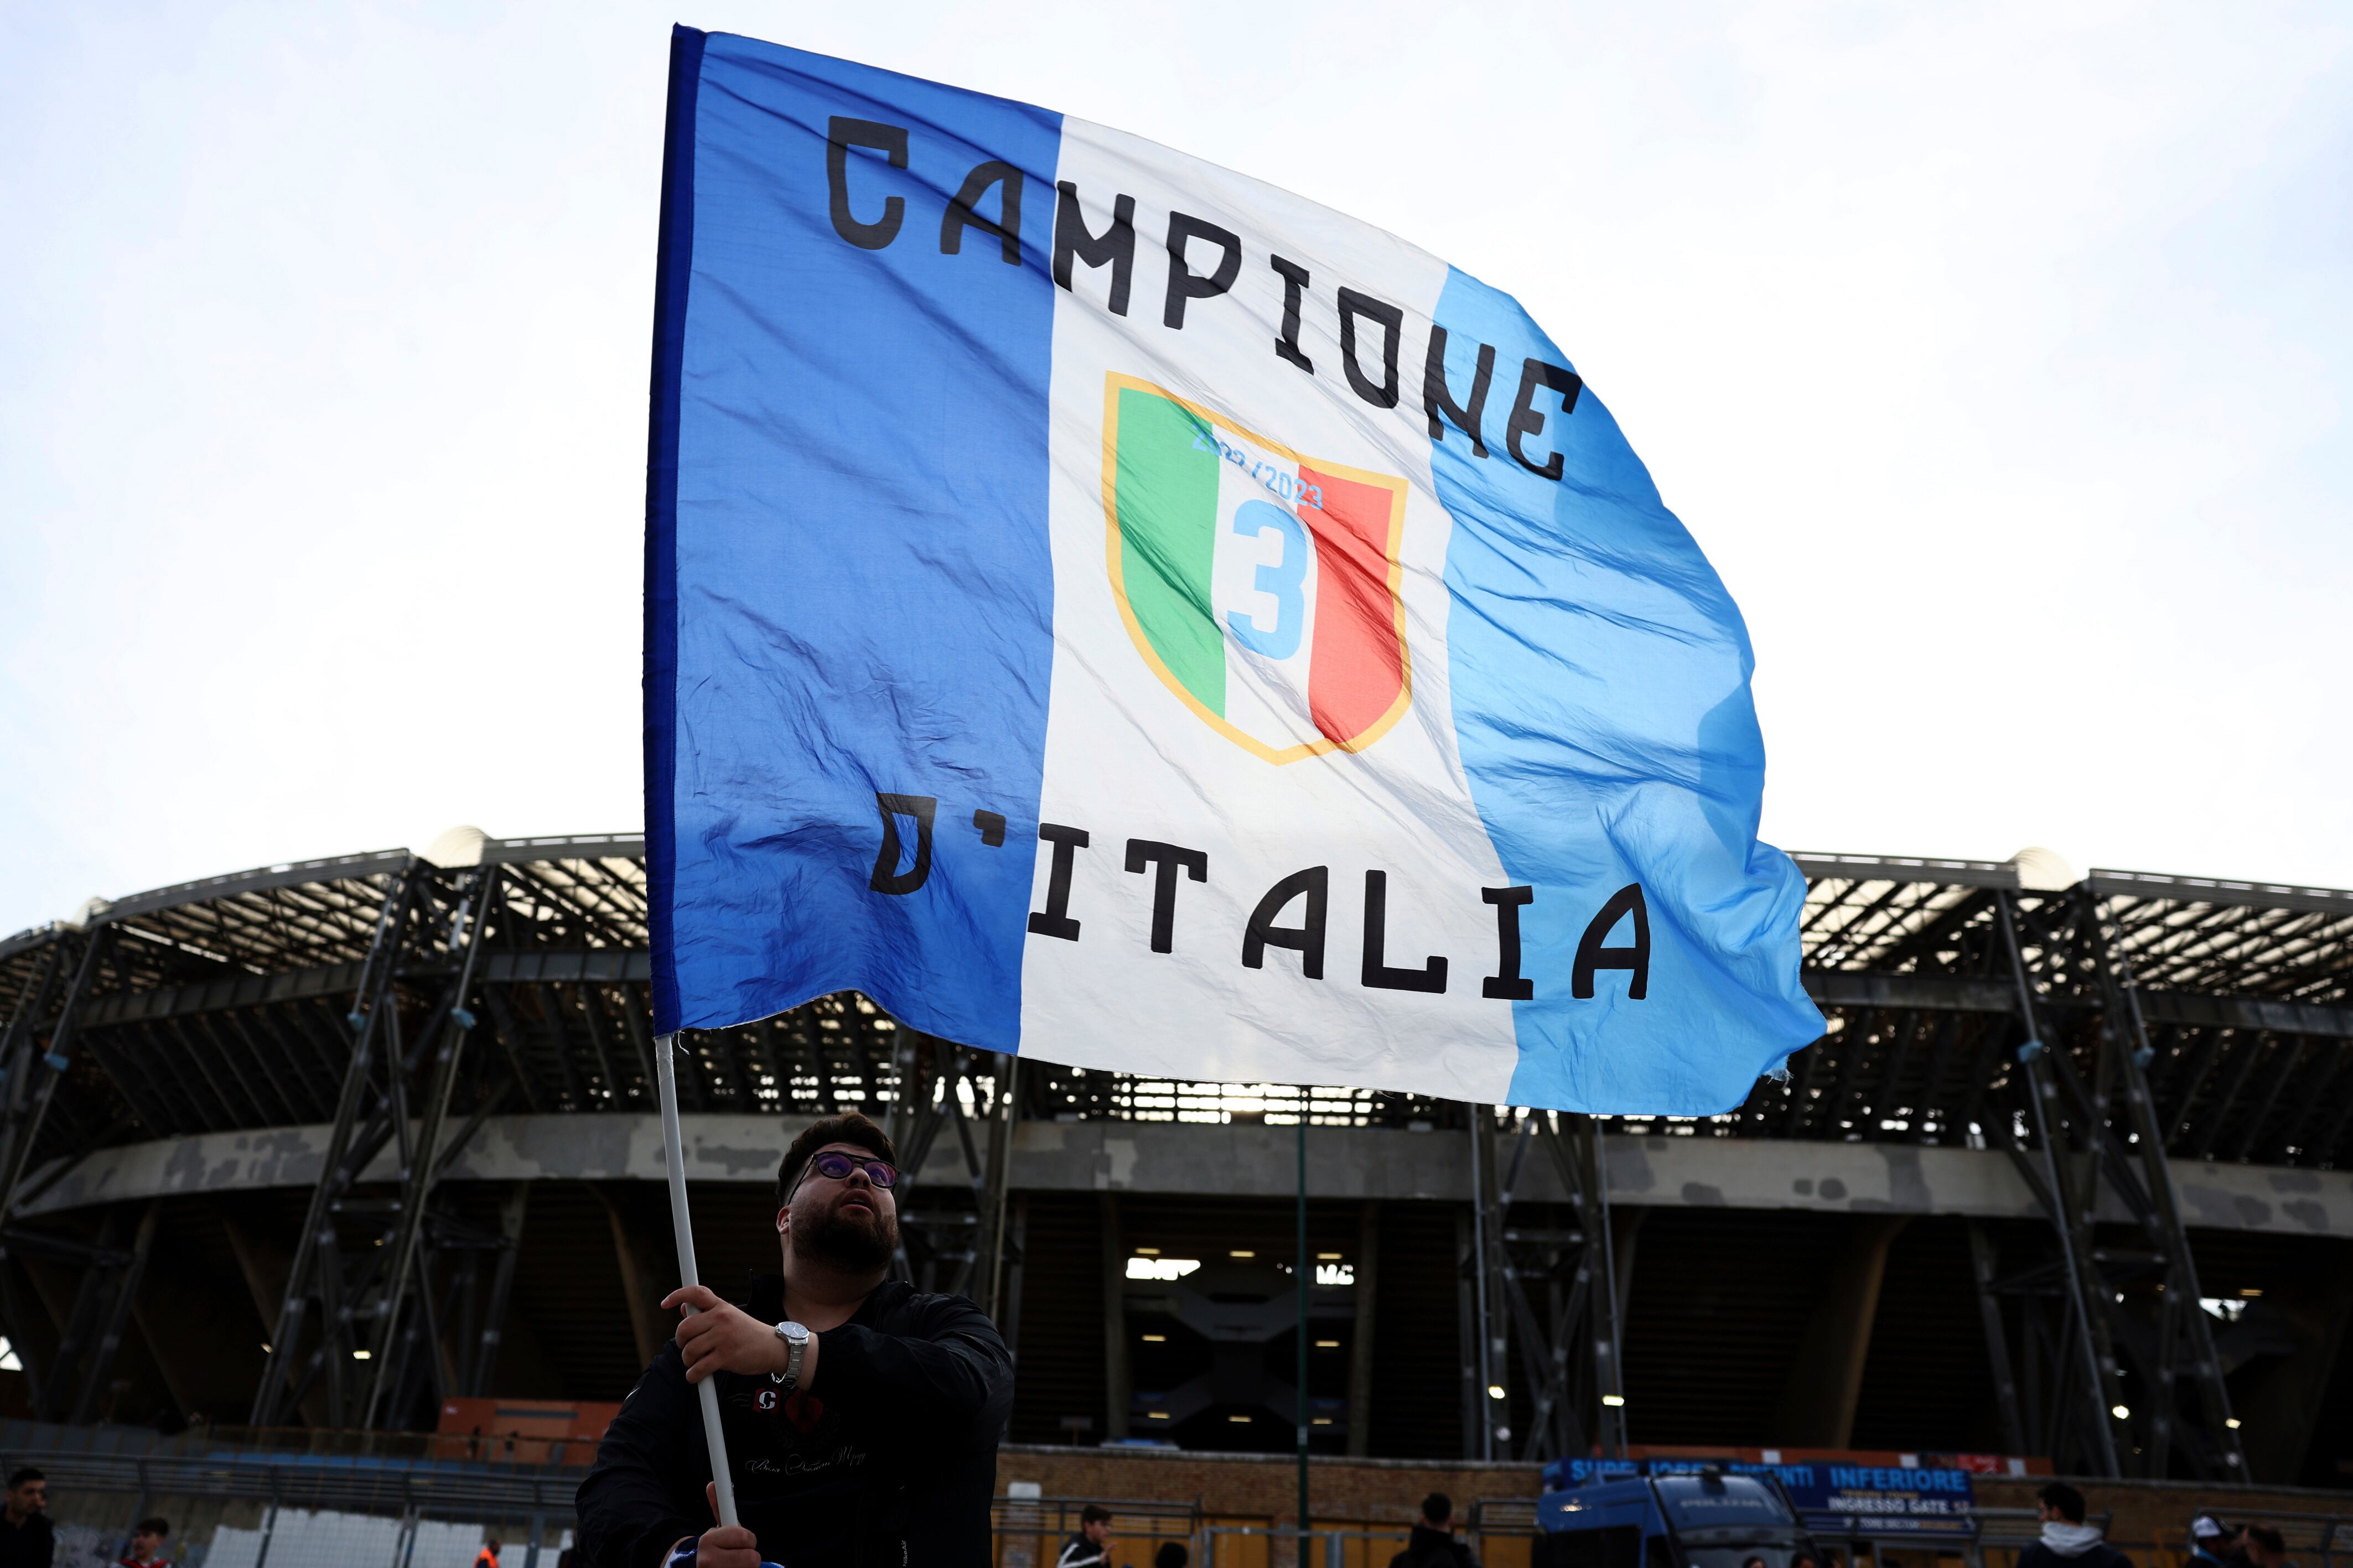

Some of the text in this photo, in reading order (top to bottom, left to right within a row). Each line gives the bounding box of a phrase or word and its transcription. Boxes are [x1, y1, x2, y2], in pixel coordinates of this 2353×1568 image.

[826, 115, 1583, 481] CAMPIONE
[1227, 499, 1308, 661] 3
[869, 792, 1651, 1000] D'ITALIA
[1827, 1496, 1906, 1513] INGRESSO
[1908, 1498, 1950, 1514] GATE
[1828, 1466, 1969, 1493] INFERIORE
